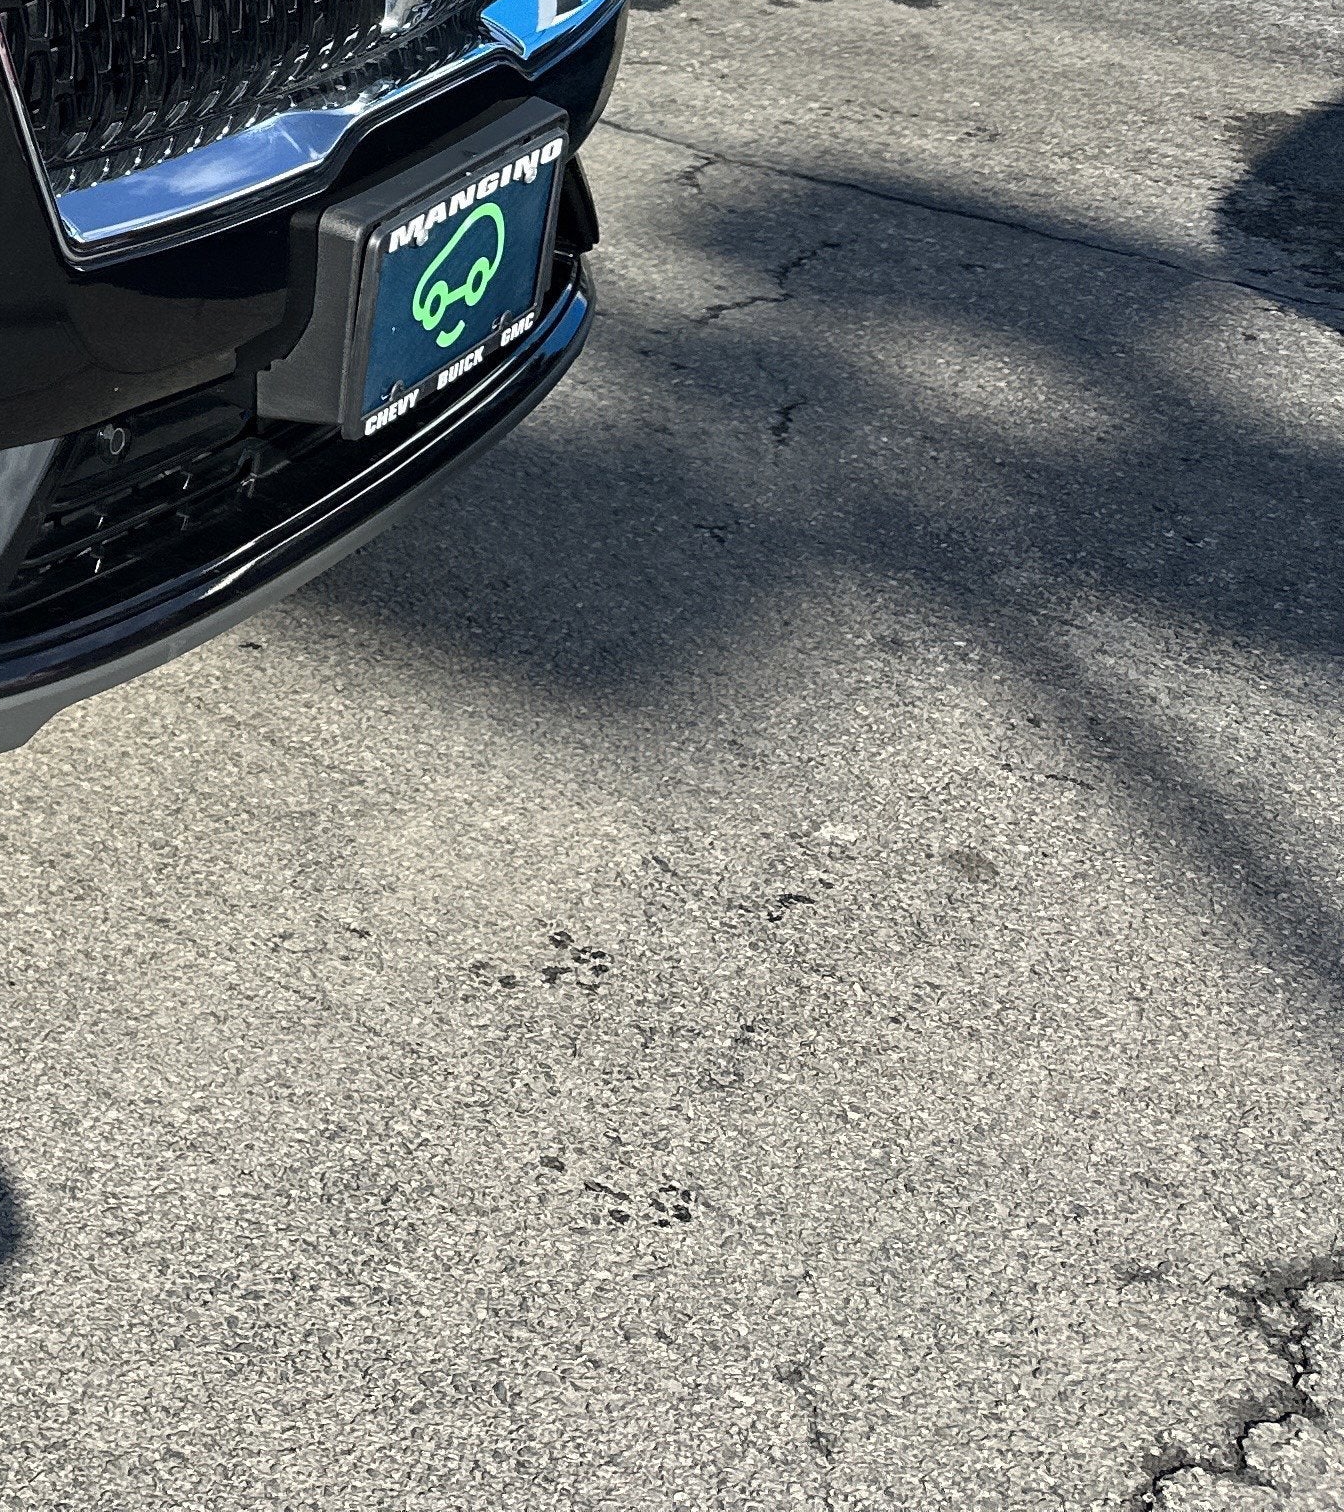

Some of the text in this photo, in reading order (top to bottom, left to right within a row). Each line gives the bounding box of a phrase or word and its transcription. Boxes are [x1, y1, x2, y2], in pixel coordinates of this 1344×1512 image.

[389, 138, 563, 253] MANGINO
[364, 312, 535, 436] CHEVY BUICK GMC
